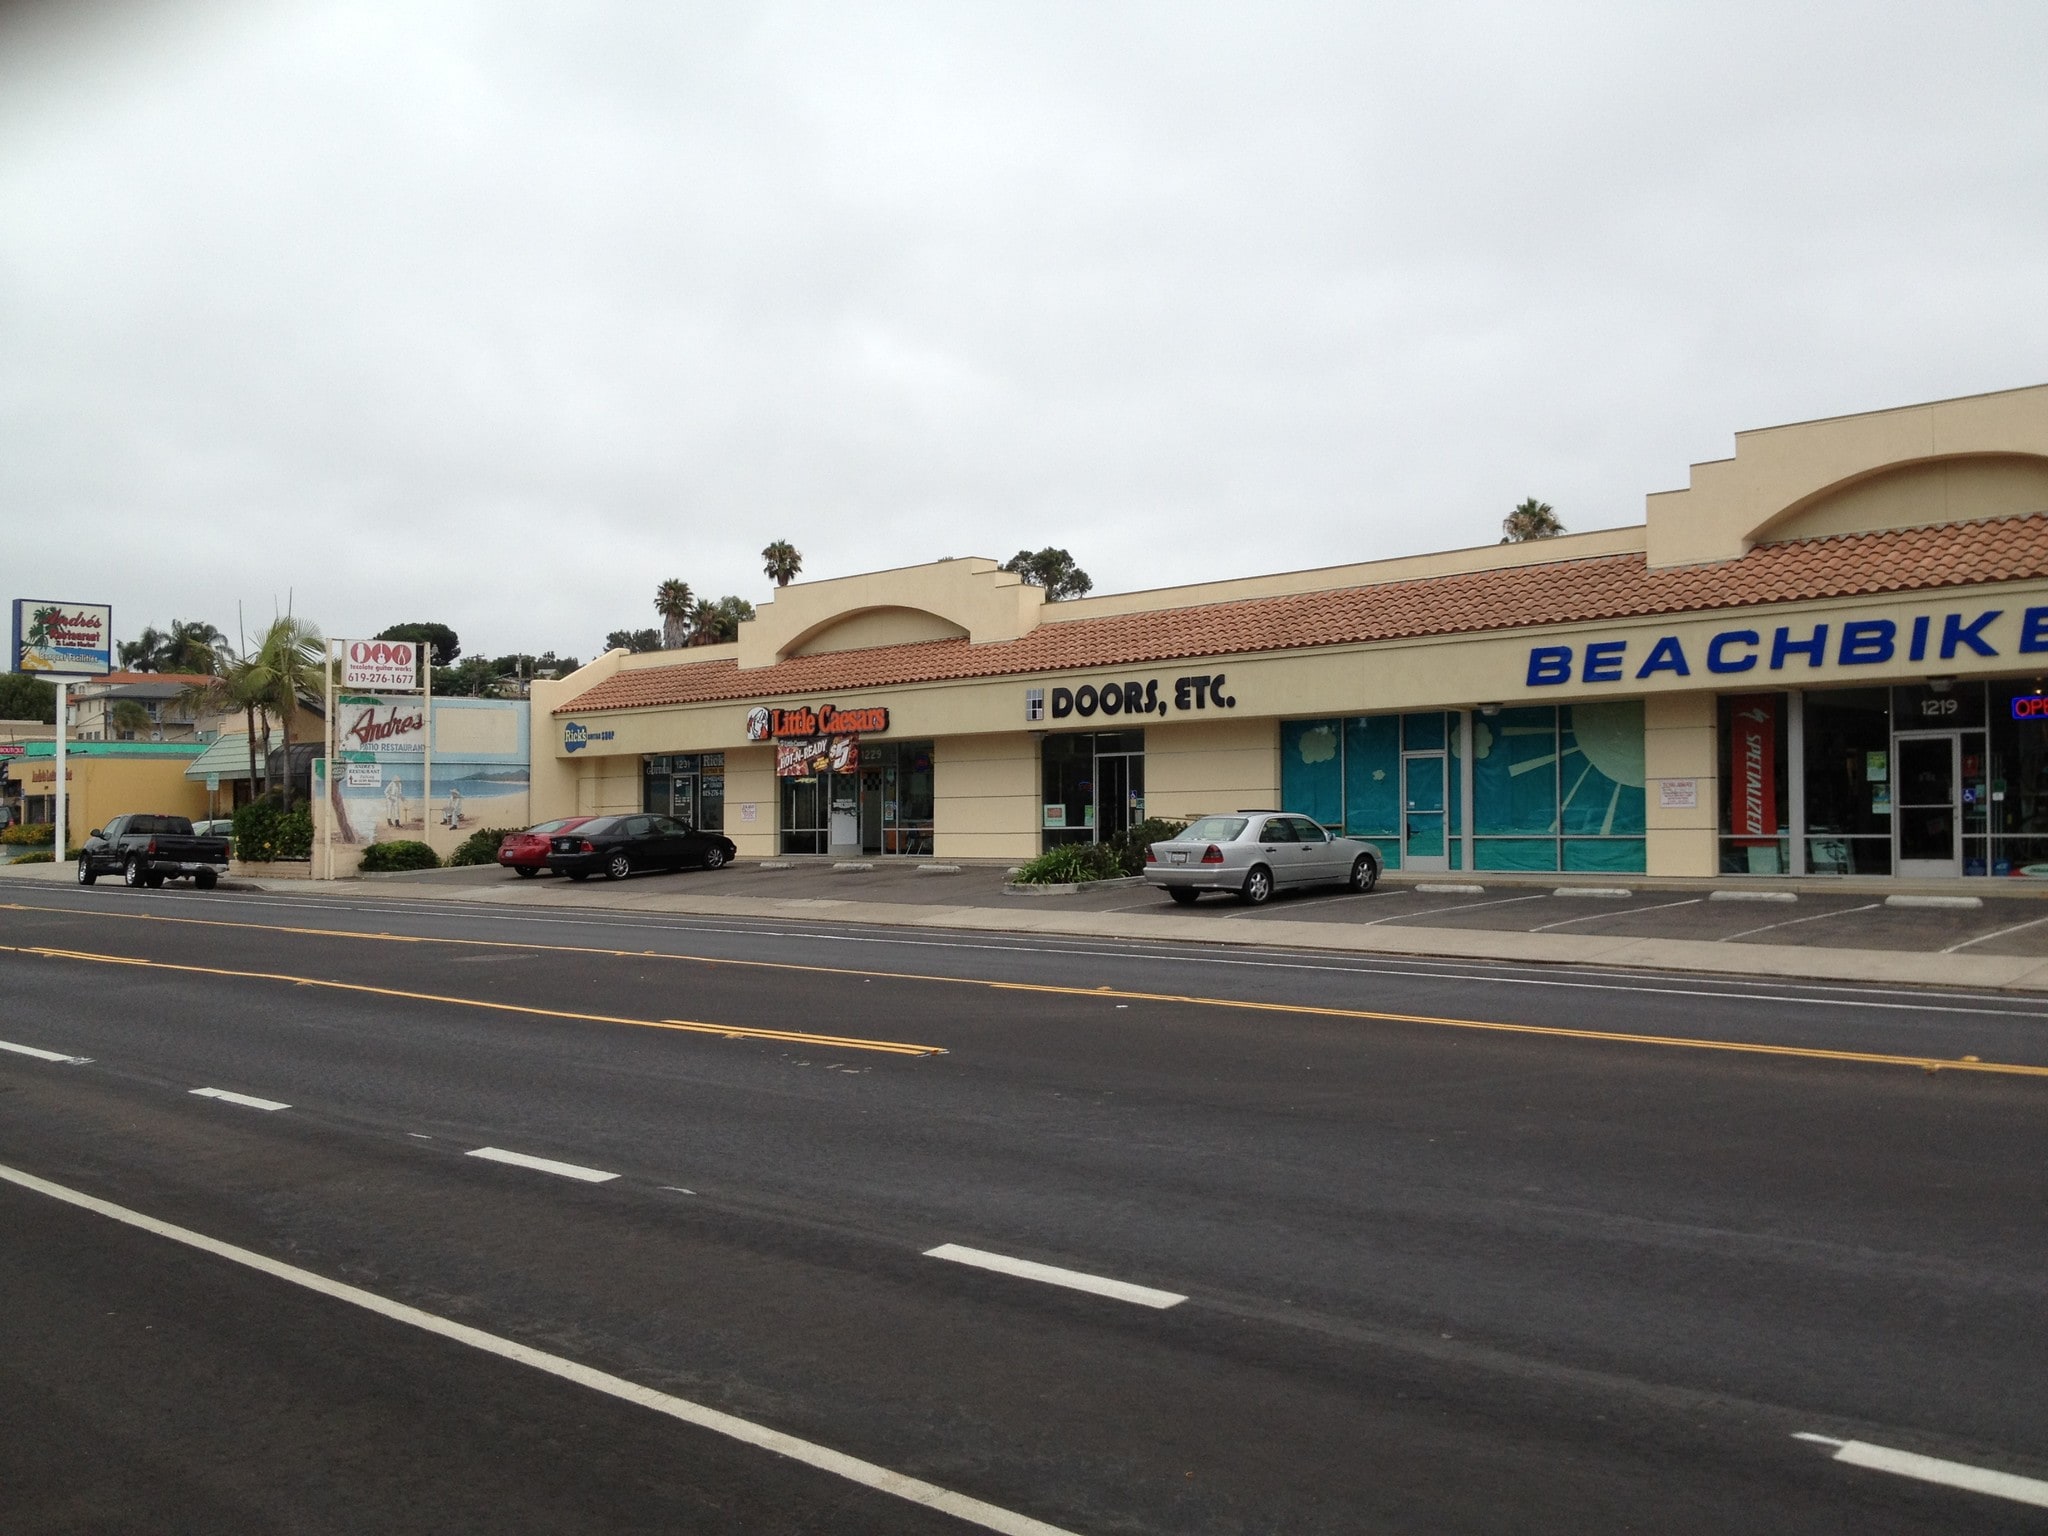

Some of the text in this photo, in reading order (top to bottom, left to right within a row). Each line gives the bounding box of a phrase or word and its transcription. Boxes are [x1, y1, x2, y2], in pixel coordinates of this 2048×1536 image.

[41, 608, 102, 628] Andrés
[375, 664, 393, 672] guitar
[348, 673, 413, 684] 619-276-1677
[1052, 674, 1236, 718] DOORS, ETC.
[1921, 700, 1958, 715] 1219
[348, 706, 424, 744] Andres
[771, 703, 886, 737] Little Caesars
[565, 729, 587, 742] Rick's
[360, 743, 426, 752] PATIO RESTAURANT
[780, 739, 828, 769] HOT-N-READY
[829, 739, 850, 769] $5
[861, 750, 882, 760] 1229
[676, 760, 690, 769] 1231
[1746, 734, 1762, 837] SPECIALIZED
